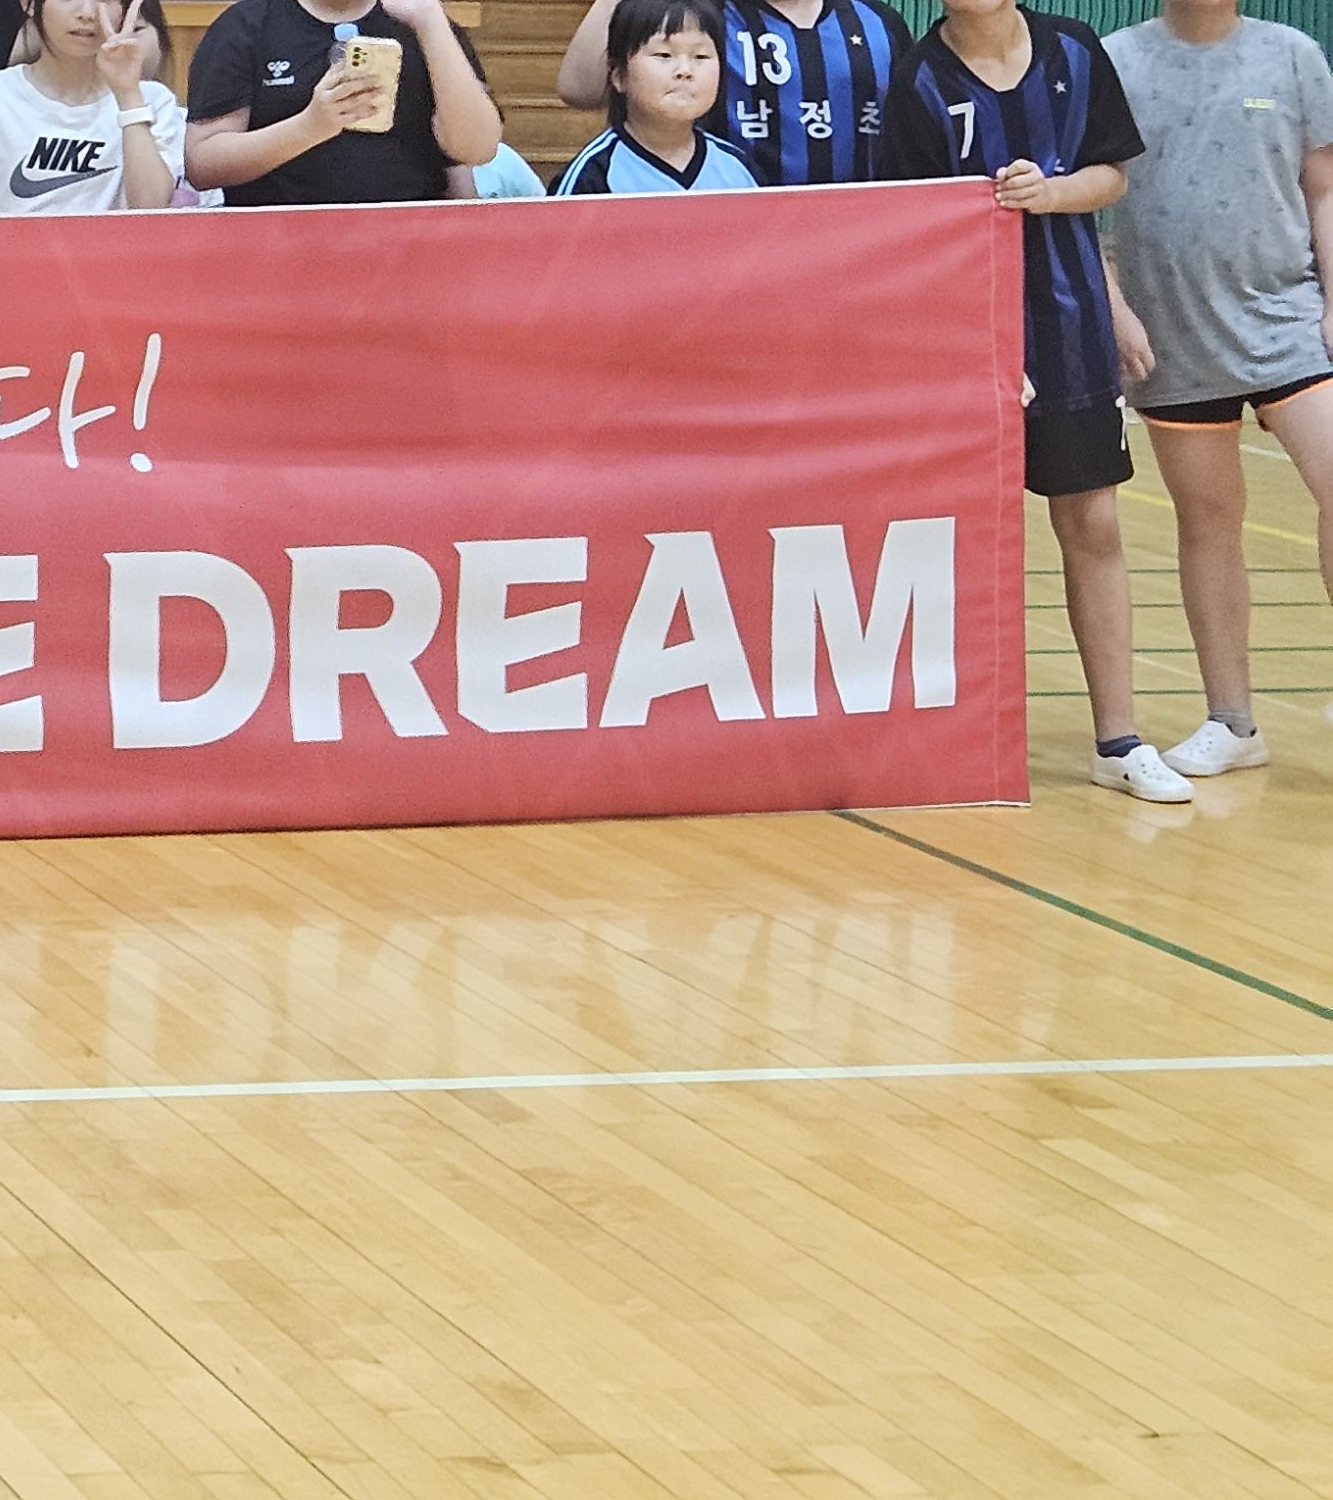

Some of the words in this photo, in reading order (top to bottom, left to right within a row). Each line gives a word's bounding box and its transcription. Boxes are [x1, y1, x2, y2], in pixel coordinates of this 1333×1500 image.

[736, 31, 792, 86] 13
[736, 99, 882, 140] 남정초
[948, 101, 976, 160] 7
[26, 136, 107, 173] NIKE
[103, 516, 957, 751] DREAM
